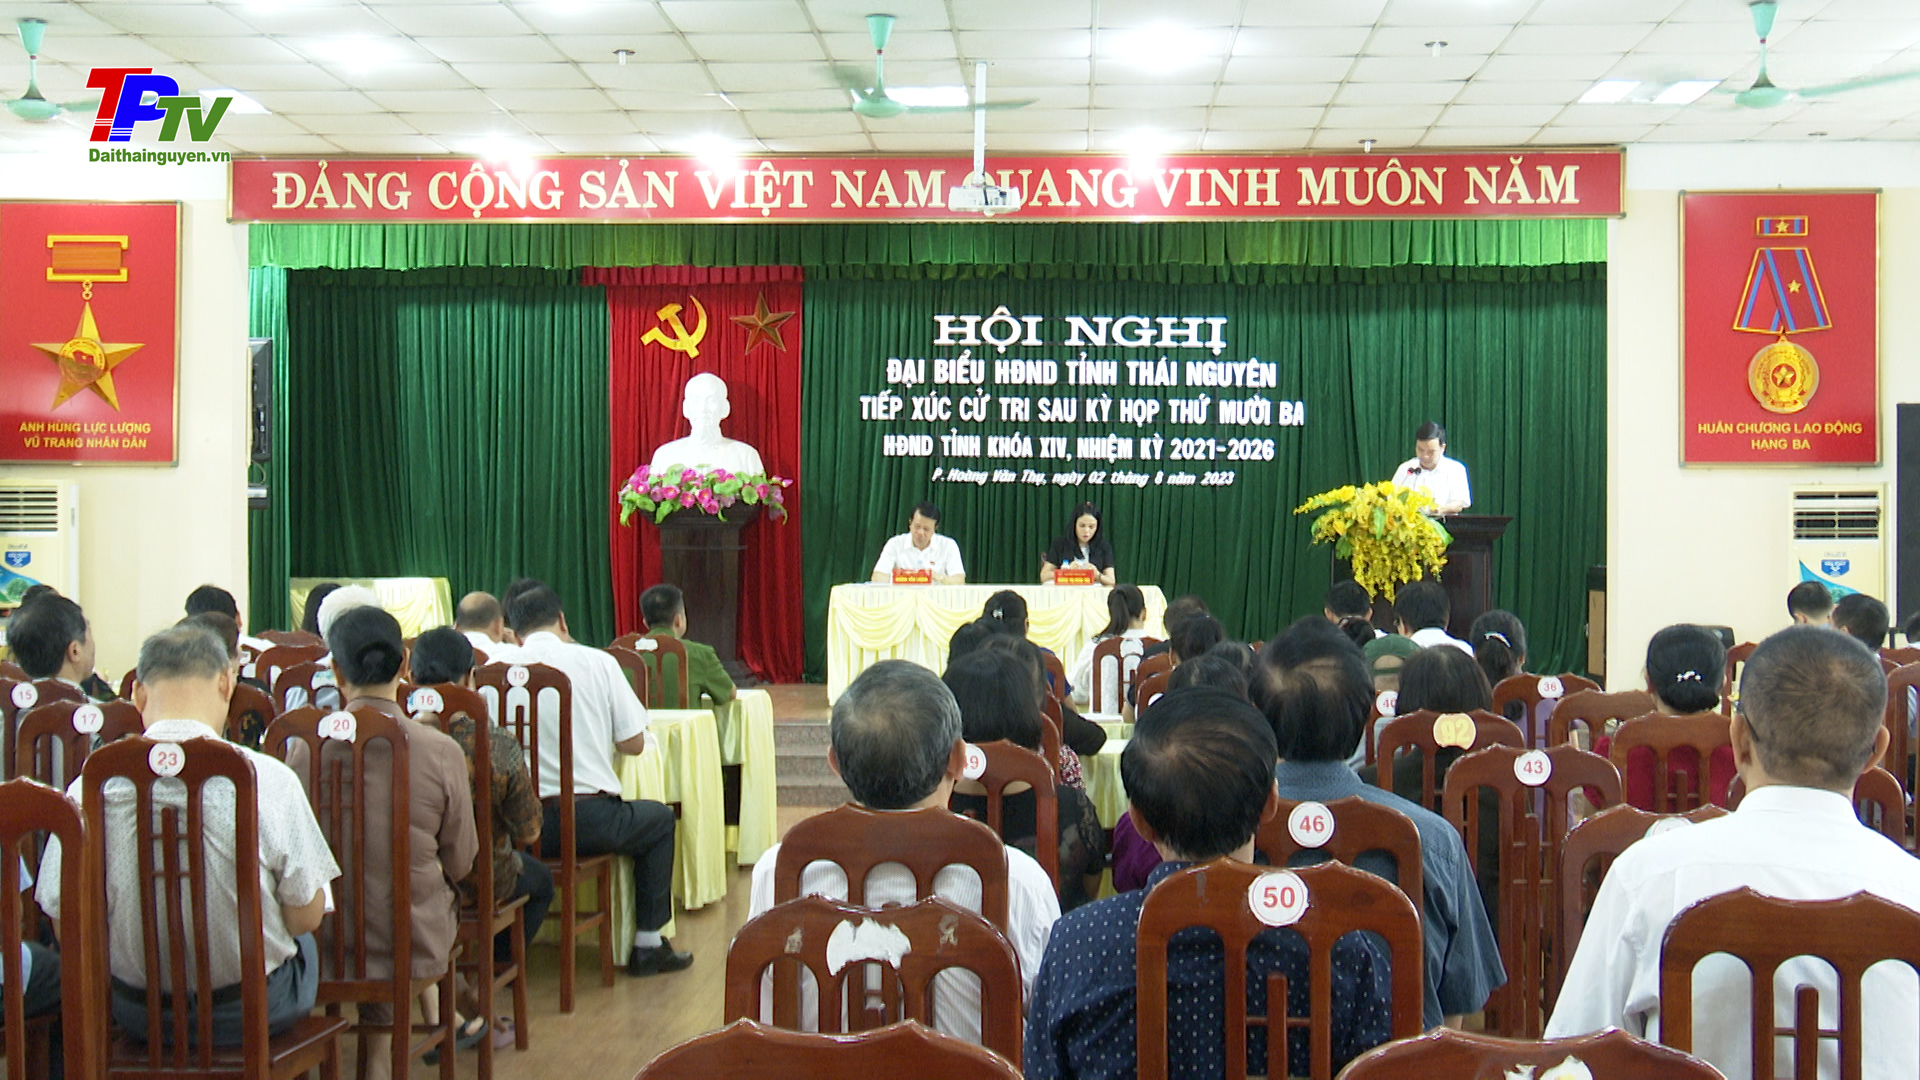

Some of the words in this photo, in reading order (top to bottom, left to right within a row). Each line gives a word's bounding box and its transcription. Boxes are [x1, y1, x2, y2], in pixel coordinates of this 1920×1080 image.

[271, 159, 412, 210] ĐẢNG
[428, 162, 564, 218] CỘNG
[579, 159, 679, 209] SẢN
[694, 161, 814, 217] VIỆT
[830, 169, 946, 208] NAM
[1150, 168, 1281, 207] VINH
[1297, 157, 1447, 206] MUÔN
[1463, 156, 1580, 204] NĂM
[934, 305, 1043, 353] HỘI
[1064, 315, 1227, 355] NGHỊ
[887, 358, 925, 388] ĐẠI
[934, 349, 985, 384] BIỂU
[995, 359, 1058, 385] HĐND
[1065, 352, 1117, 386] TỈNH
[1126, 356, 1178, 386] THÁI
[1186, 357, 1277, 388] NGUYÊN
[860, 389, 903, 420] TIẾP
[911, 390, 952, 422] XÚC
[959, 387, 991, 422] CỬ
[999, 397, 1030, 422] TRI
[1038, 397, 1077, 422] SAU
[1085, 392, 1112, 423] KỲ
[1120, 398, 1160, 427] HỌP
[1168, 393, 1210, 424] THỨ
[1219, 393, 1271, 426] MƯỜI
[1279, 401, 1304, 426] BA
[20, 422, 45, 432] ANH
[47, 420, 81, 433] HÙNG
[83, 422, 108, 435] LỰC
[109, 422, 152, 435] LƯỢNG
[1698, 420, 1733, 434] HUÂN
[1736, 422, 1791, 434] CHƯƠNG
[1794, 423, 1822, 434] LAO
[1824, 420, 1863, 436] ĐỘNG
[24, 435, 40, 448] VŨ
[43, 437, 83, 448] TRANG
[86, 436, 119, 448] NHÂN
[122, 436, 147, 448] DÂN
[883, 435, 934, 456] HĐND
[941, 427, 981, 457] TỈNH
[987, 431, 1033, 458] KHÓA
[1039, 436, 1072, 461] XIV,
[1077, 433, 1133, 464] NHIỆM
[1140, 432, 1164, 460] KỲ
[1169, 437, 1275, 461] 2021-2026
[1751, 439, 1788, 451] HẠNG
[1792, 439, 1811, 450] BA
[931, 467, 945, 482] P.
[947, 468, 988, 486] Hoàng
[992, 469, 1017, 482] Văn
[1052, 471, 1086, 487] ngày
[1088, 471, 1106, 485] 02
[1110, 470, 1149, 489] tháng
[1154, 471, 1164, 485] 8
[1167, 471, 1196, 485] năm
[1201, 471, 1235, 486] 2023
[19, 691, 32, 700] 15
[81, 713, 97, 725] 17
[333, 719, 350, 731] 20
[1440, 719, 1471, 744] 92
[157, 751, 178, 766] 23
[1523, 761, 1544, 775] 43
[1299, 815, 1325, 833] 46
[1263, 886, 1296, 908] 50
